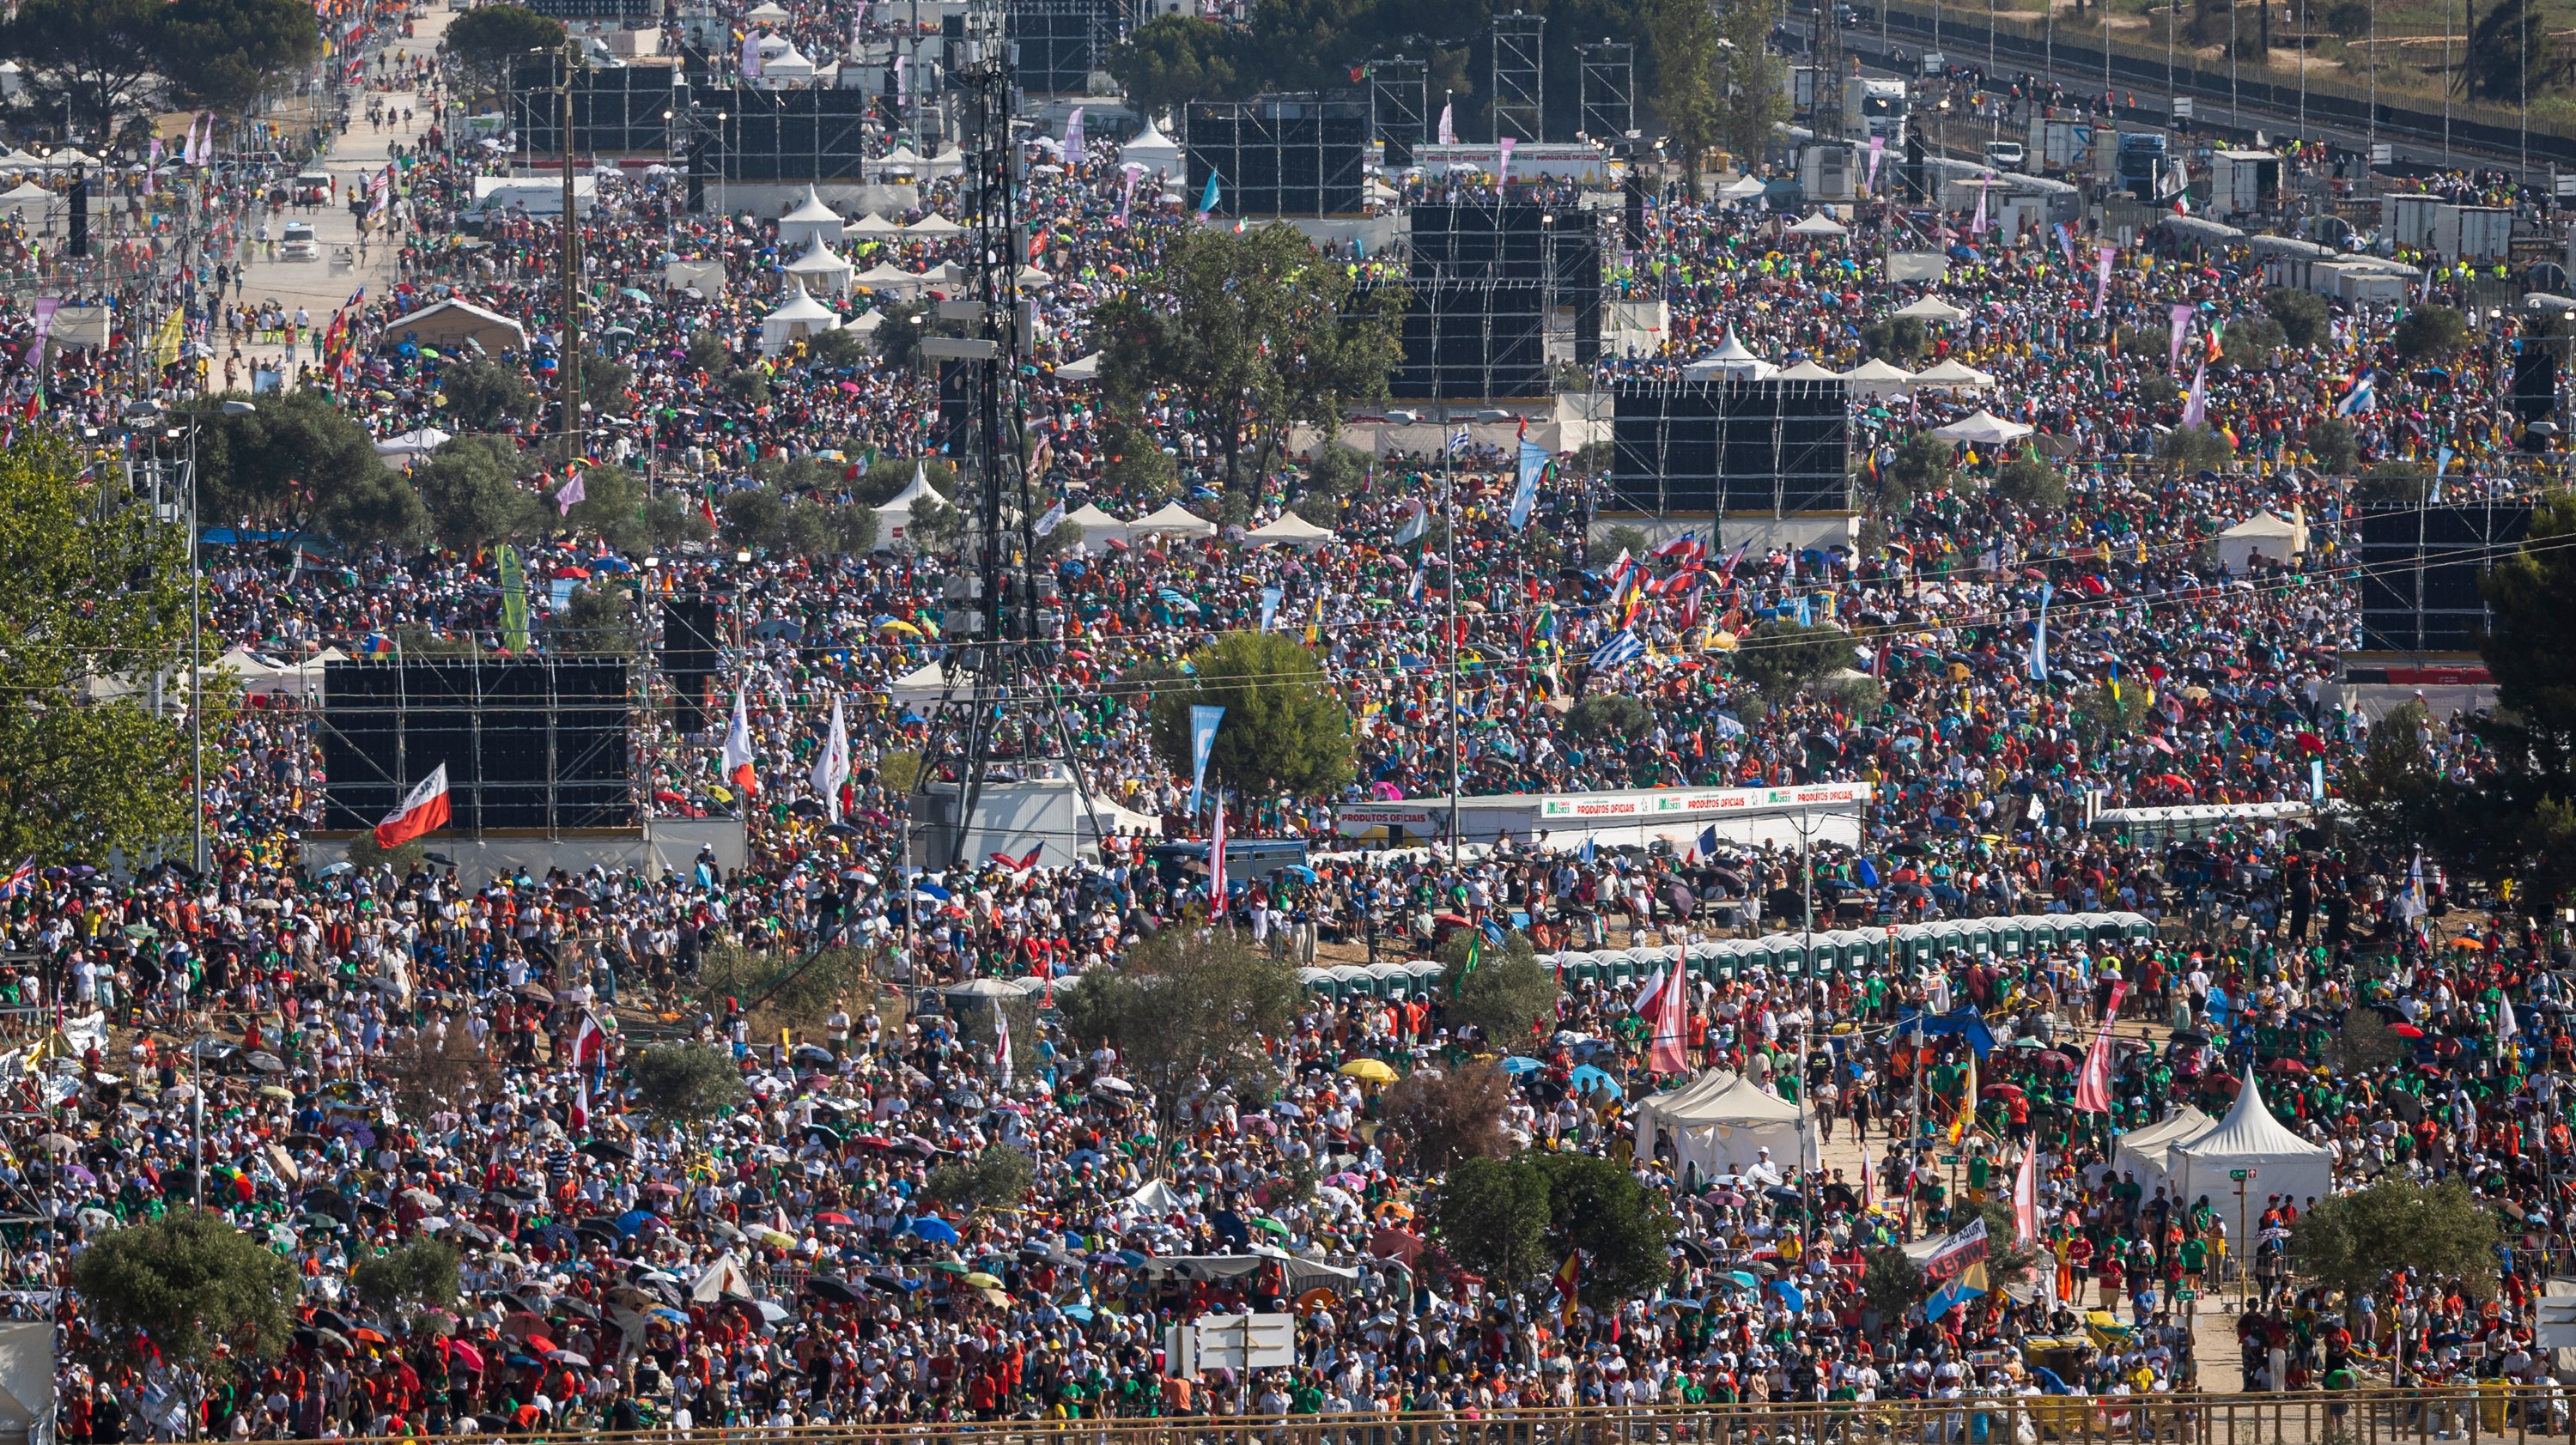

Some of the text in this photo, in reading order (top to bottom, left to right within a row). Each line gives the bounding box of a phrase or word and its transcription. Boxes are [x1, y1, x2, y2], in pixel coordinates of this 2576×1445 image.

[1797, 790, 1853, 802] PRODUTOS OFICIAIS
[1577, 804, 1635, 815] PRODUTOS OFICIAIS
[1687, 798, 1745, 810] PRODUTOS OFICIAIS
[1341, 813, 1426, 823] PRODUTOS OFICIAIS
